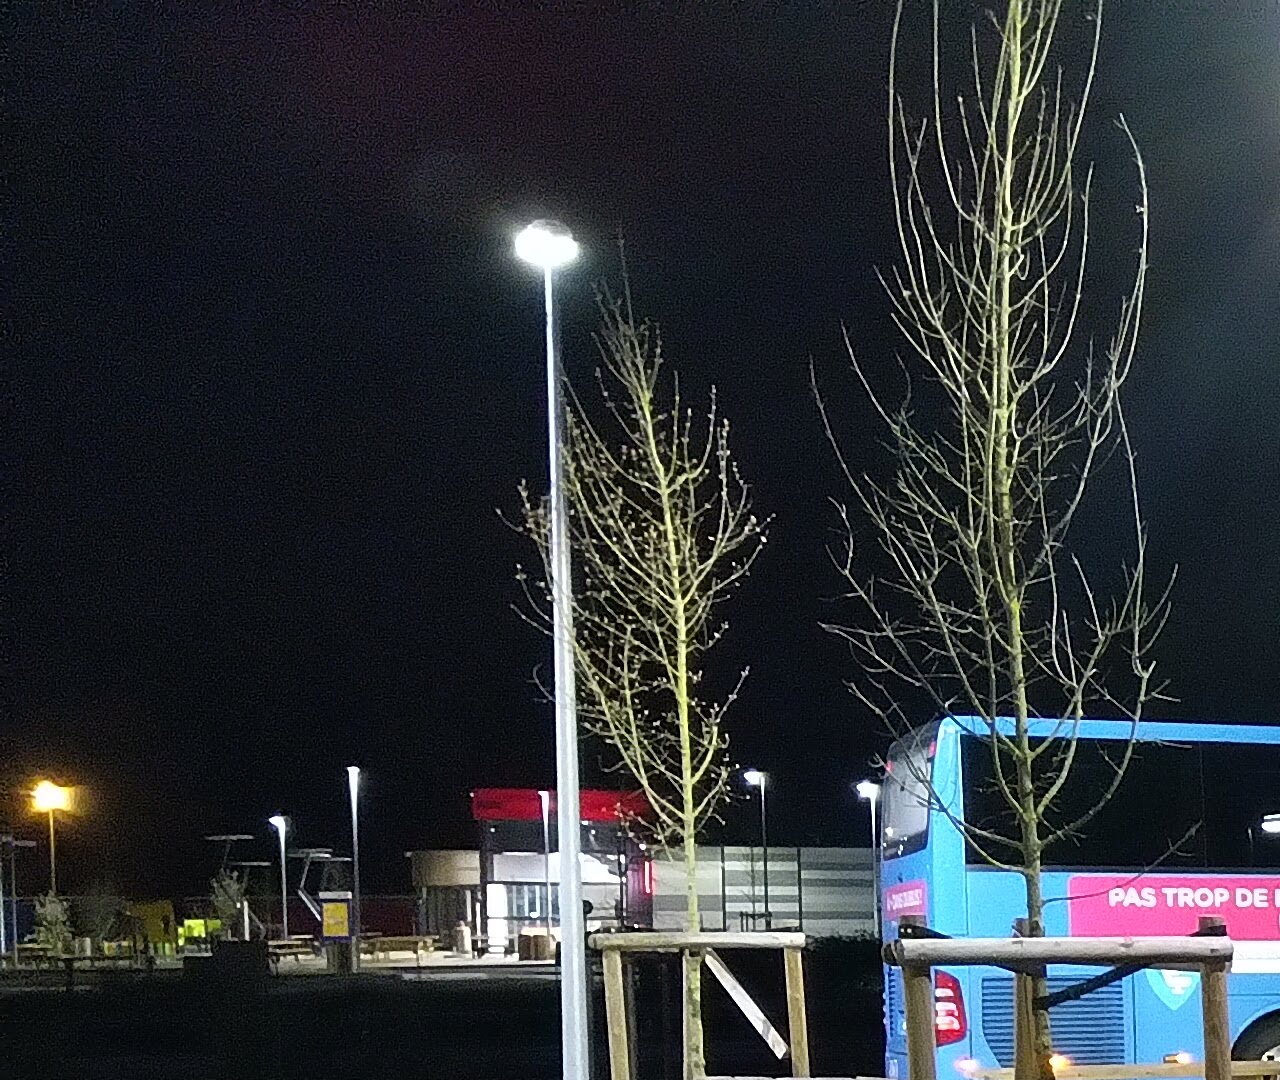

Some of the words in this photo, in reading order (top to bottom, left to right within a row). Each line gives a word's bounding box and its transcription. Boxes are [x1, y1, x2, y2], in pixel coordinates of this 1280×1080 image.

[1108, 887, 1157, 908] PAS
[1162, 887, 1230, 908] TROP
[1235, 888, 1268, 908] DE
